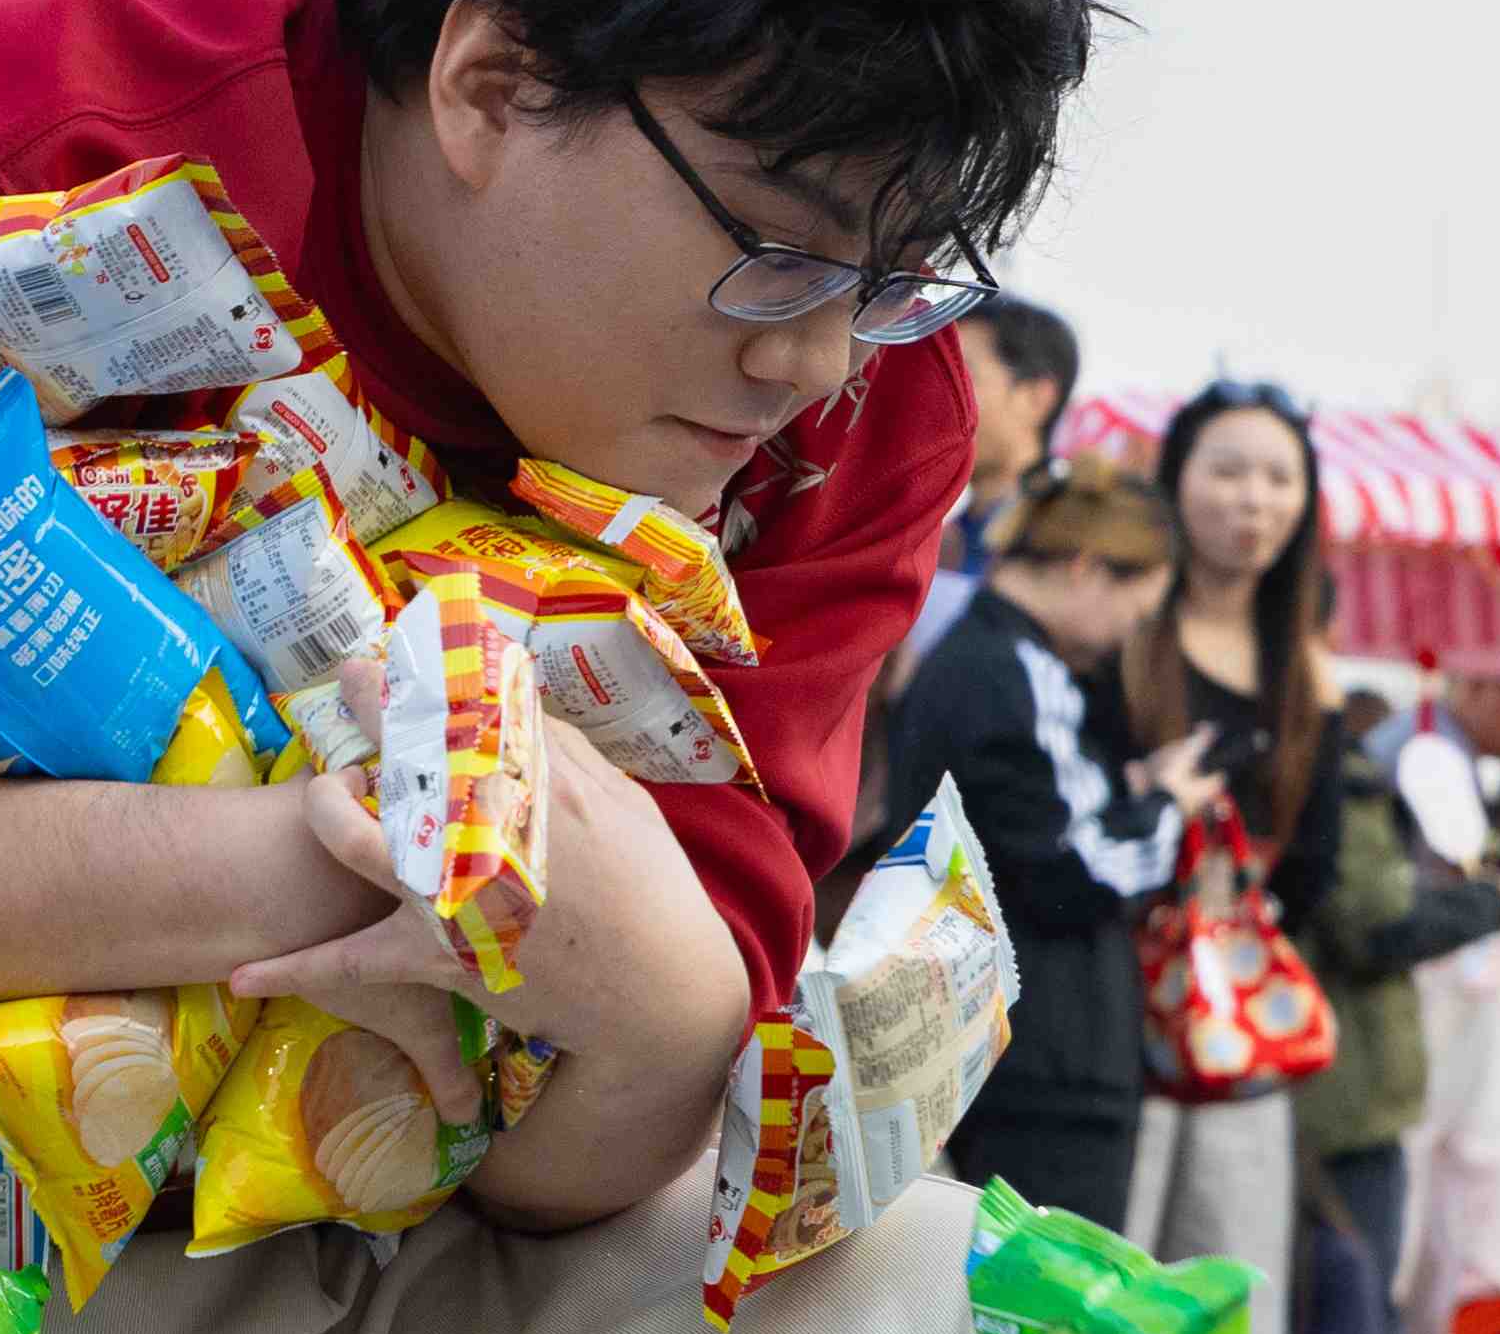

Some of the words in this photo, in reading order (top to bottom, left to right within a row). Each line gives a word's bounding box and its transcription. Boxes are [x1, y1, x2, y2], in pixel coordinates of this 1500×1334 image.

[80, 464, 133, 487] Oishi
[32, 604, 104, 688] 口味纯正
